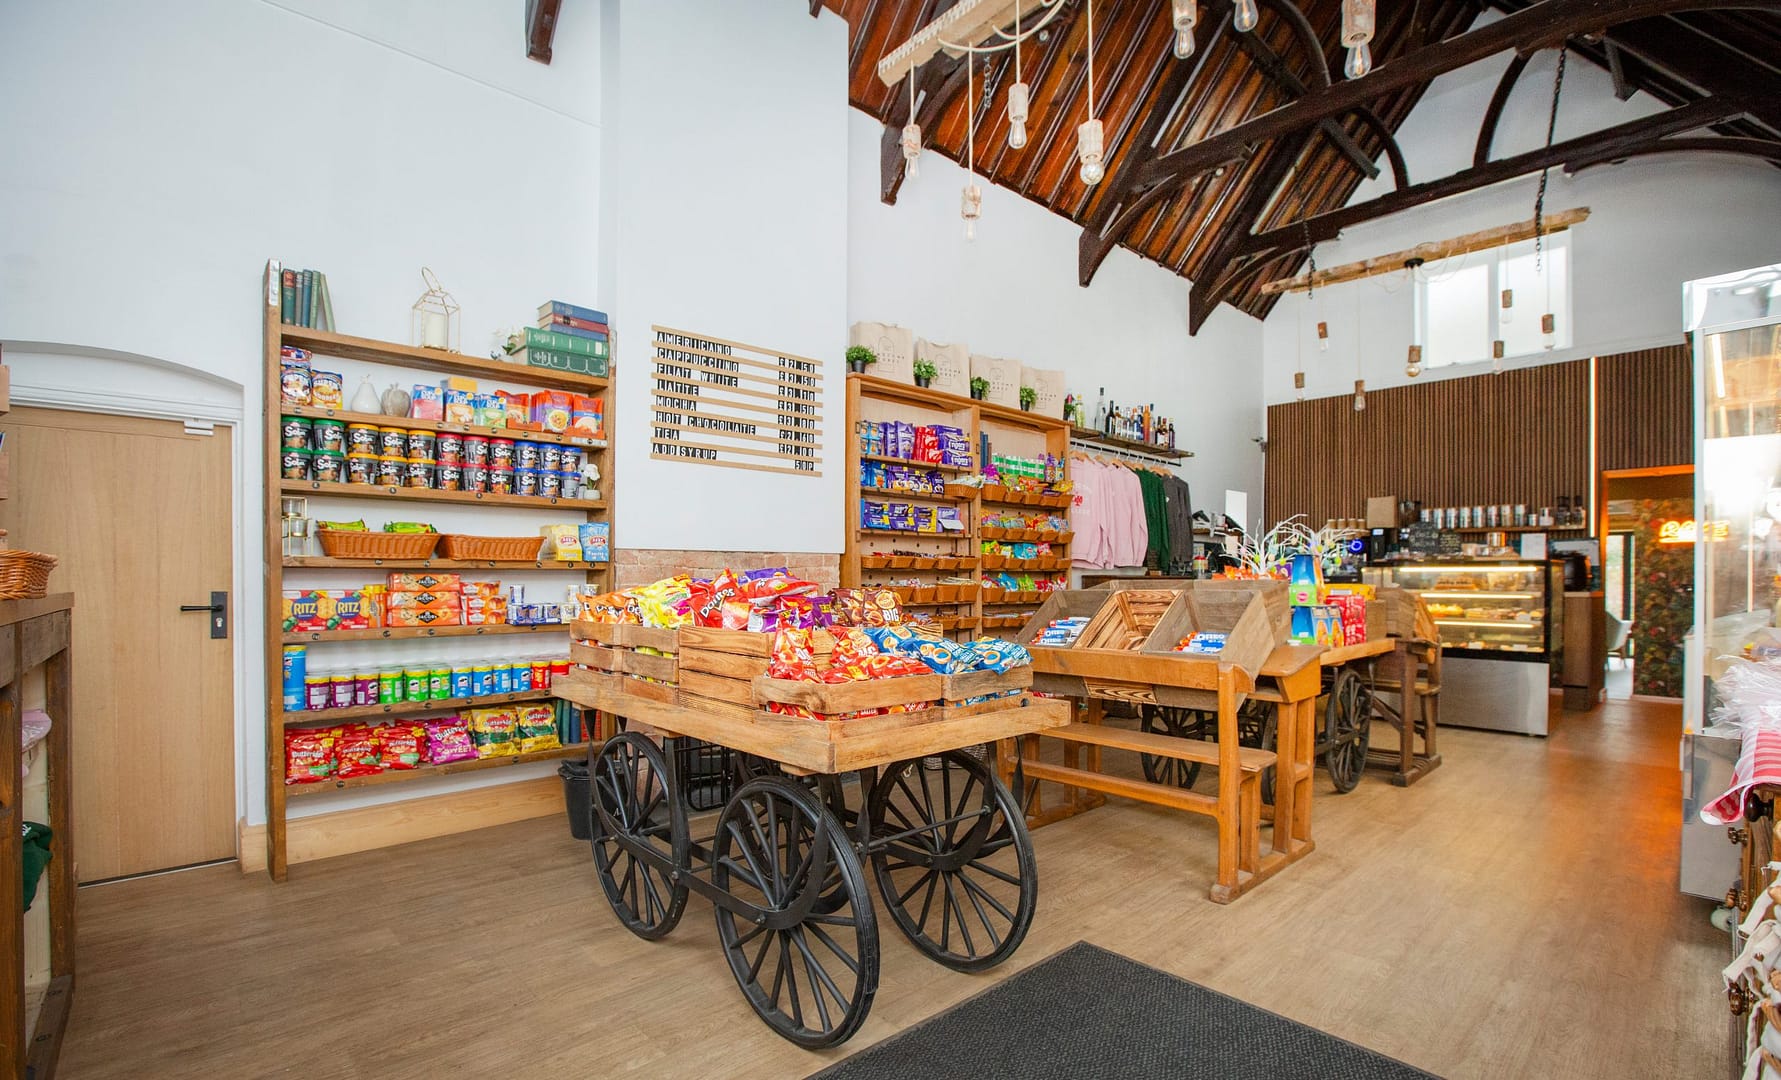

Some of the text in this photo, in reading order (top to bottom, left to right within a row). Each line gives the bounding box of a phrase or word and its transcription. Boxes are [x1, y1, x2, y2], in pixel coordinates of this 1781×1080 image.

[657, 332, 731, 355] AMERICANO
[657, 347, 739, 372] CAPPUCCINO
[657, 363, 738, 387] FLAT WHITE
[657, 379, 699, 396] LATTE
[656, 395, 696, 411] MOCHA
[656, 411, 756, 435] HOT CHOCOLATE
[655, 427, 679, 441] TEA
[653, 443, 717, 460] ADD SYRUP
[294, 603, 316, 614] RITZ
[337, 602, 359, 613] RITZ
[700, 588, 735, 618] Doritos
[882, 609, 899, 621] BIG
